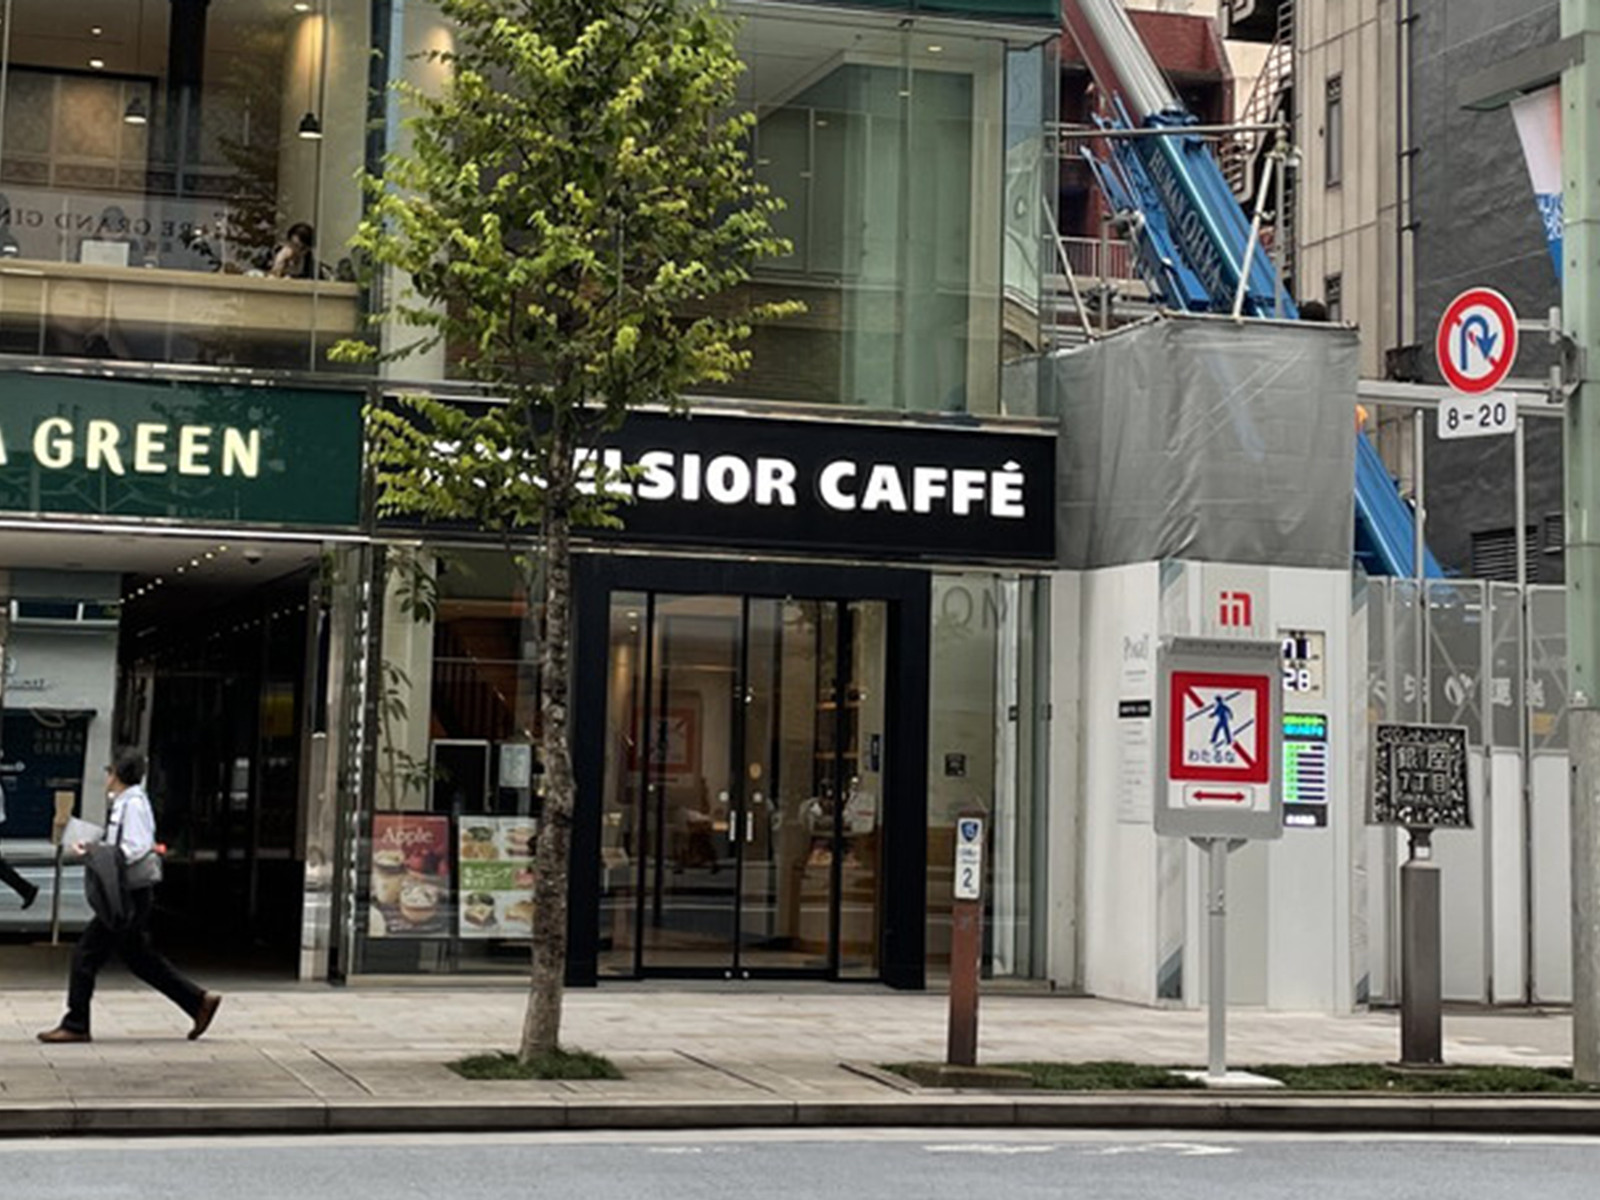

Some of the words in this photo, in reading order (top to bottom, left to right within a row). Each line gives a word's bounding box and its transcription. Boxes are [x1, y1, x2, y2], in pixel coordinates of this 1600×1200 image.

[1447, 403, 1507, 429] 8-20
[33, 417, 260, 478] GREEN
[421, 438, 796, 505] ELSIOR
[1188, 750, 1236, 765] わたるな
[382, 826, 434, 846] Apple
[963, 867, 973, 889] 2
